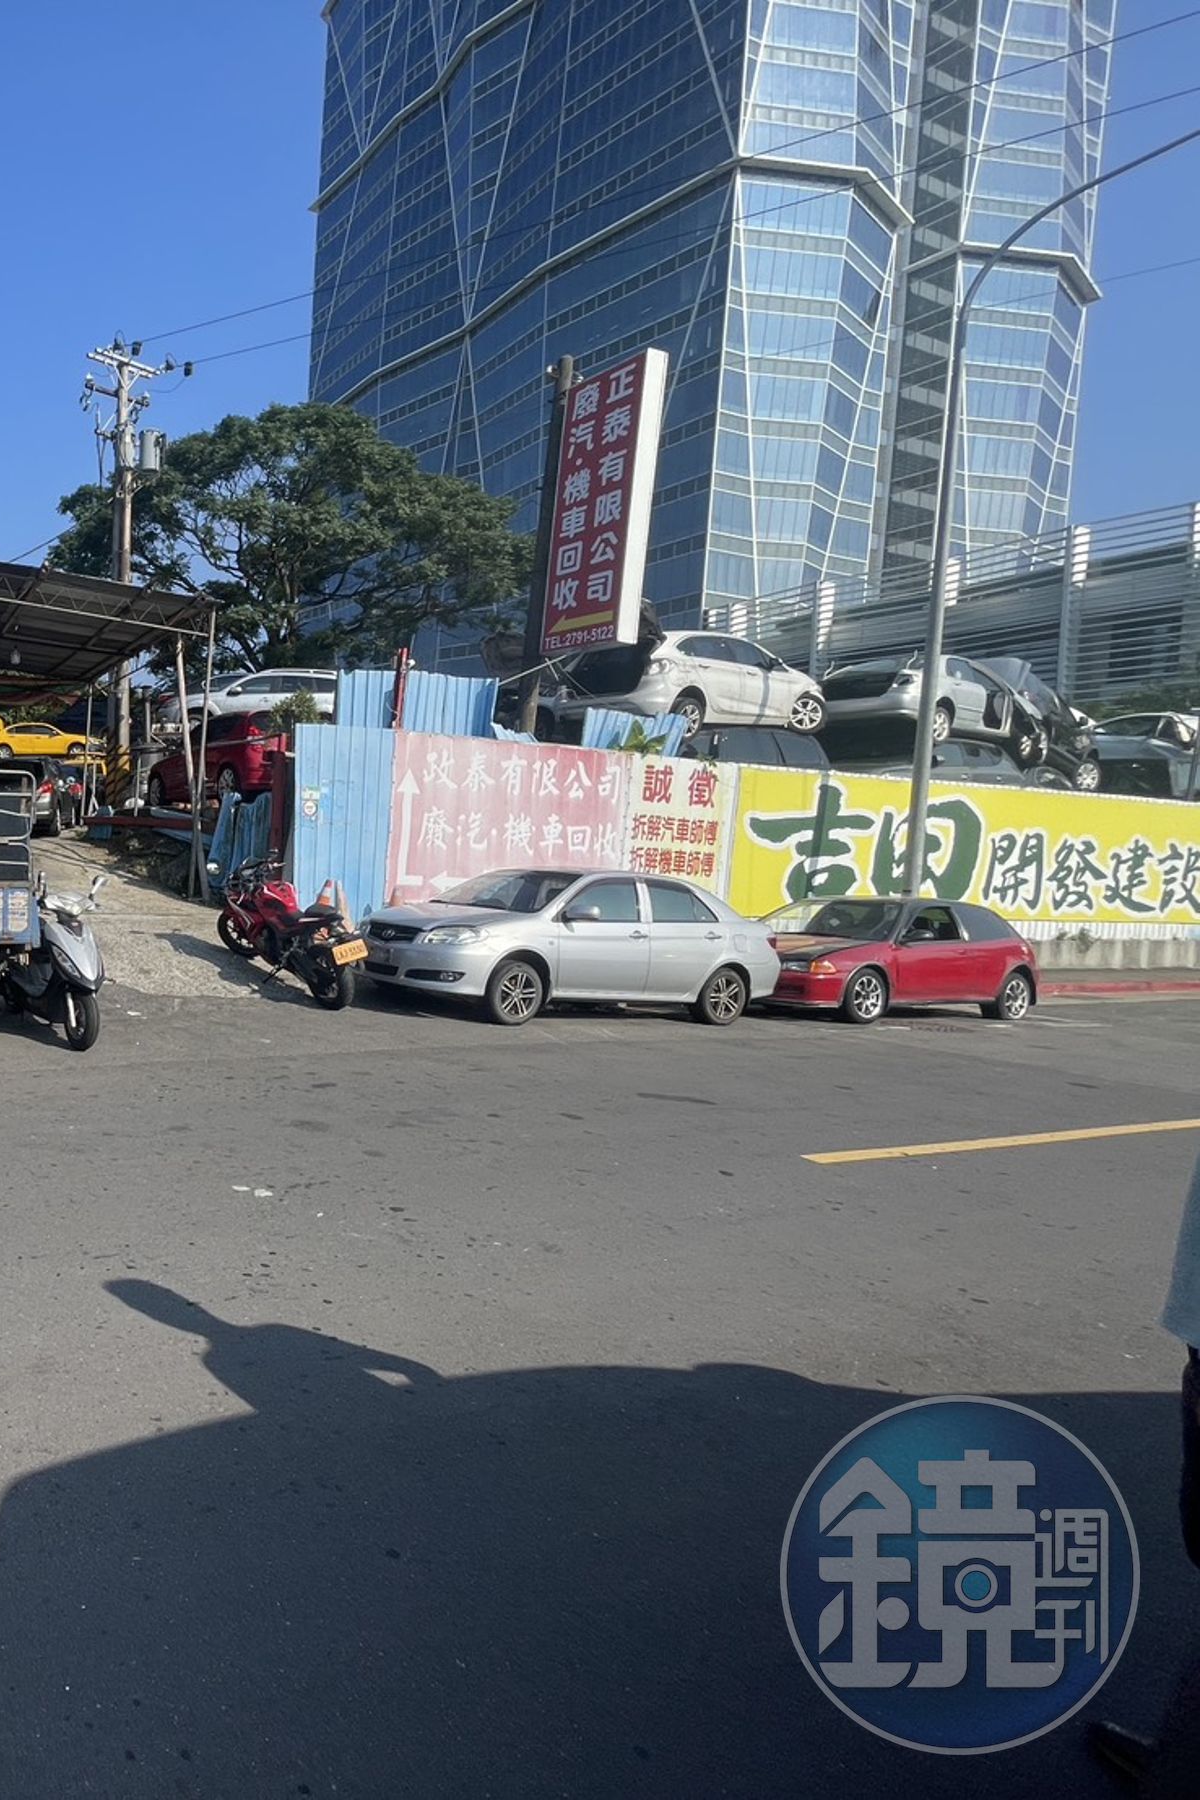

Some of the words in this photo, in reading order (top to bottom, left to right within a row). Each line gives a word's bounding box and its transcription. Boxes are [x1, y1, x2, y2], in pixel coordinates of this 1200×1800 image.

[586, 362, 638, 603] 正泰有限公司
[642, 764, 719, 808] 誠徵
